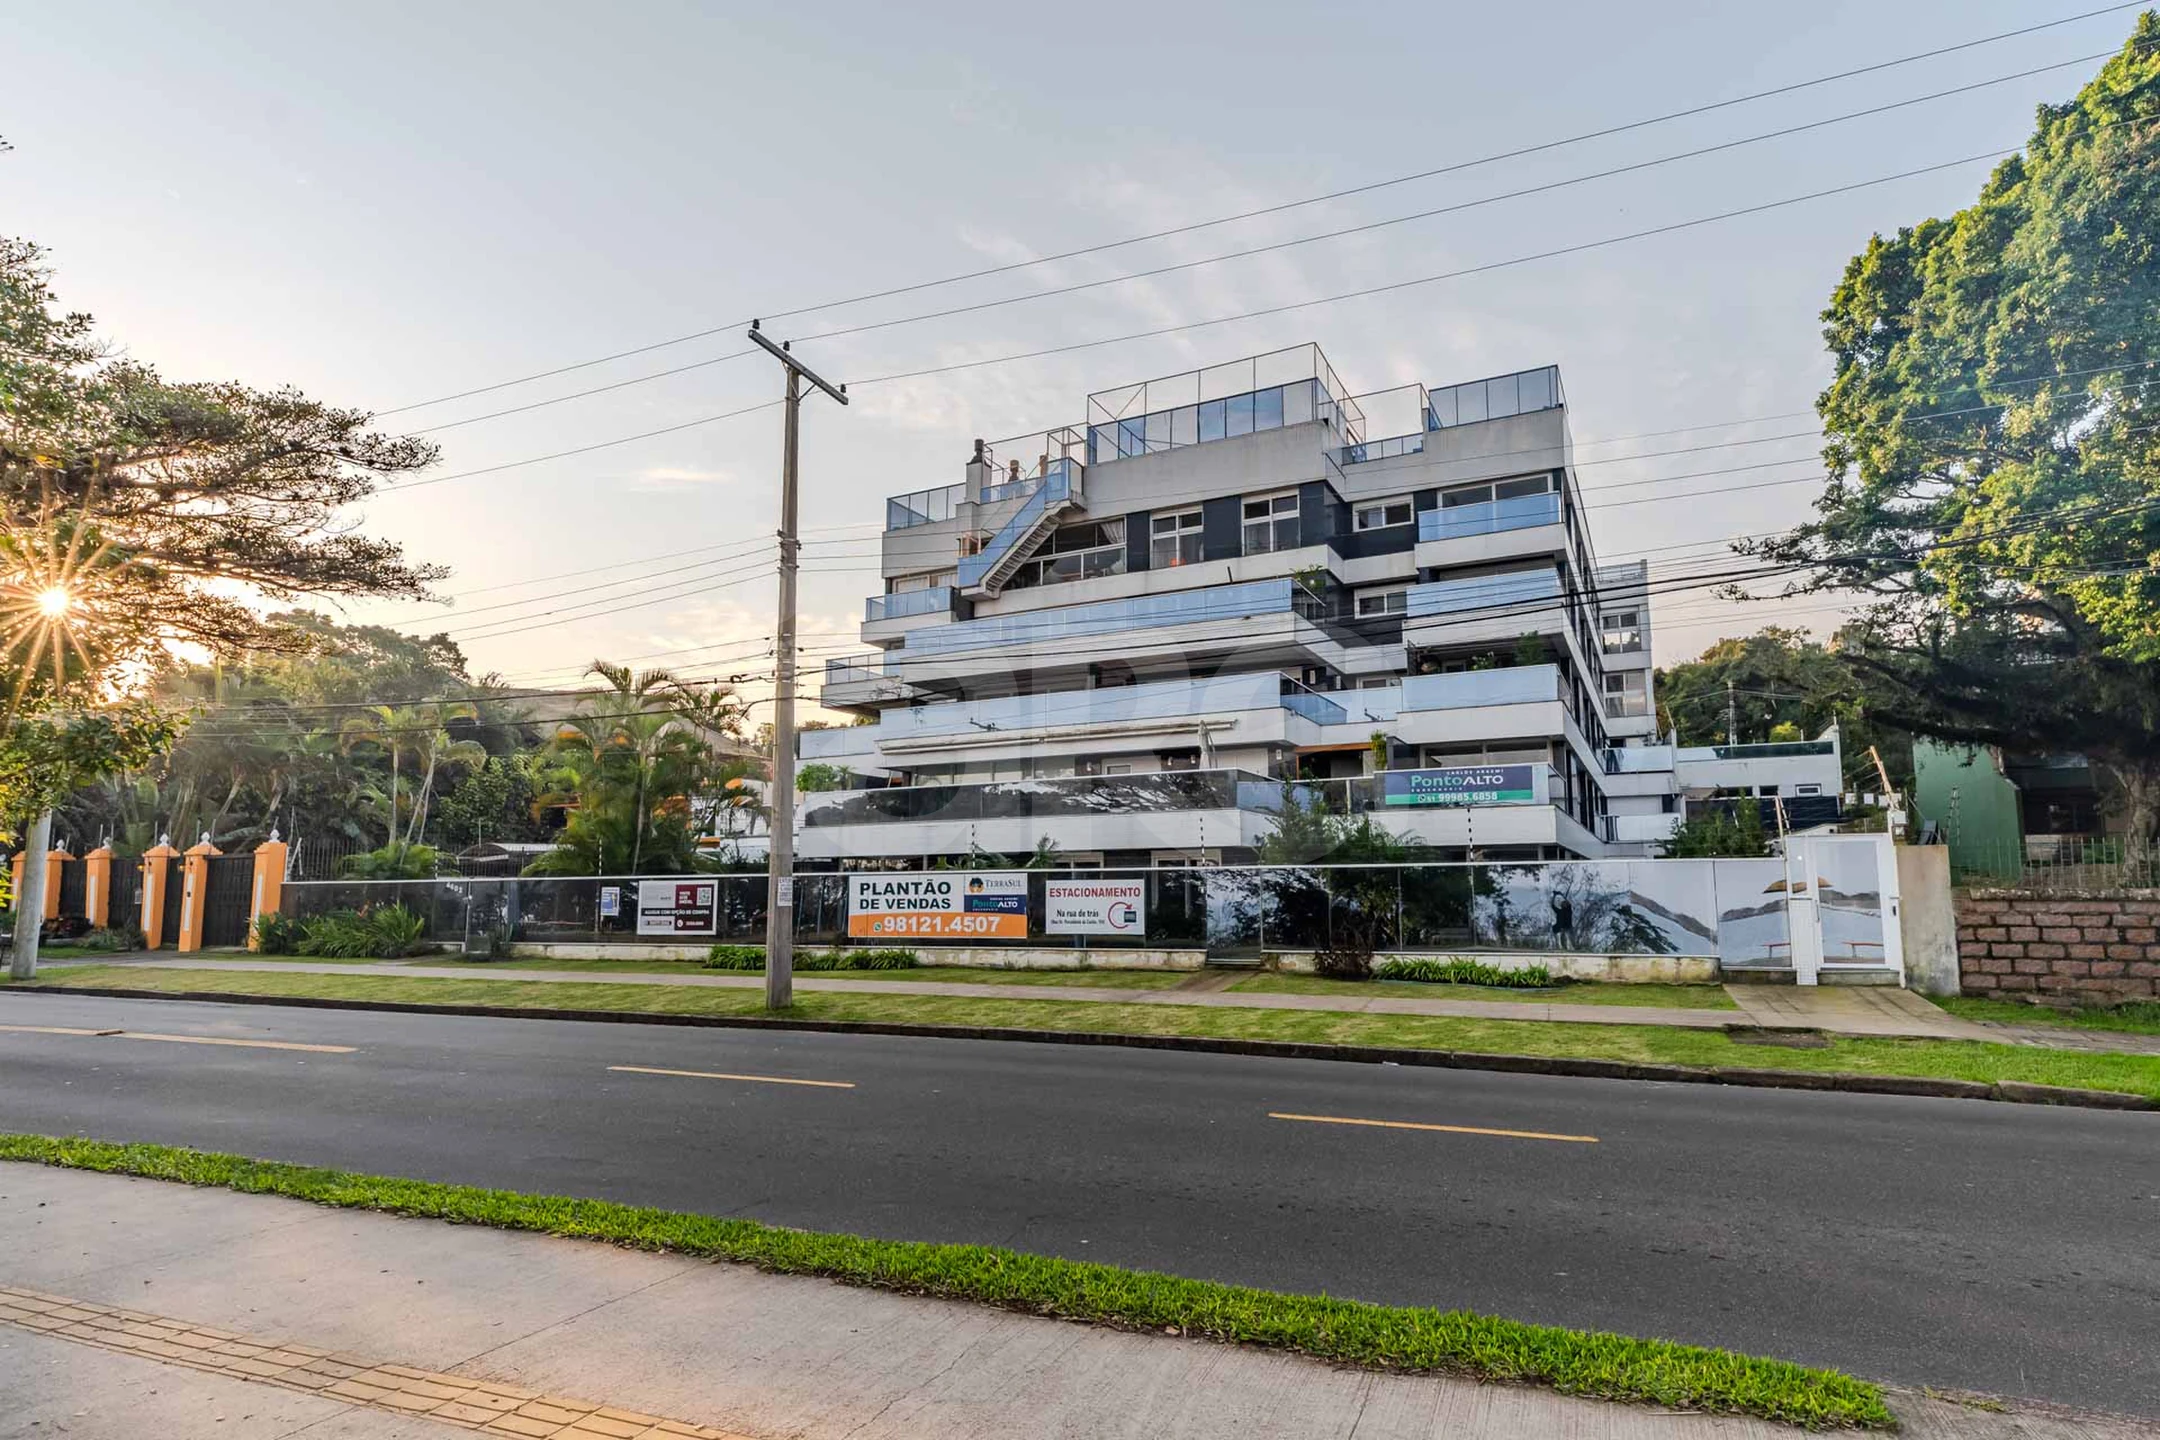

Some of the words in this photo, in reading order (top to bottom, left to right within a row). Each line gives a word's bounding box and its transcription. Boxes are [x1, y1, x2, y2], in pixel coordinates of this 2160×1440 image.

[1411, 774, 1504, 787] PontoALTO
[860, 879, 951, 896] PLANTÃO
[1049, 887, 1141, 898] ESTACIONAMENTO
[860, 898, 879, 909] DE
[885, 898, 951, 910] VENDAS
[1056, 909, 1065, 917] Na
[1066, 910, 1077, 918] rua
[1078, 909, 1086, 917] de
[1087, 909, 1099, 917] trás
[884, 916, 1001, 933] 98121.4507
